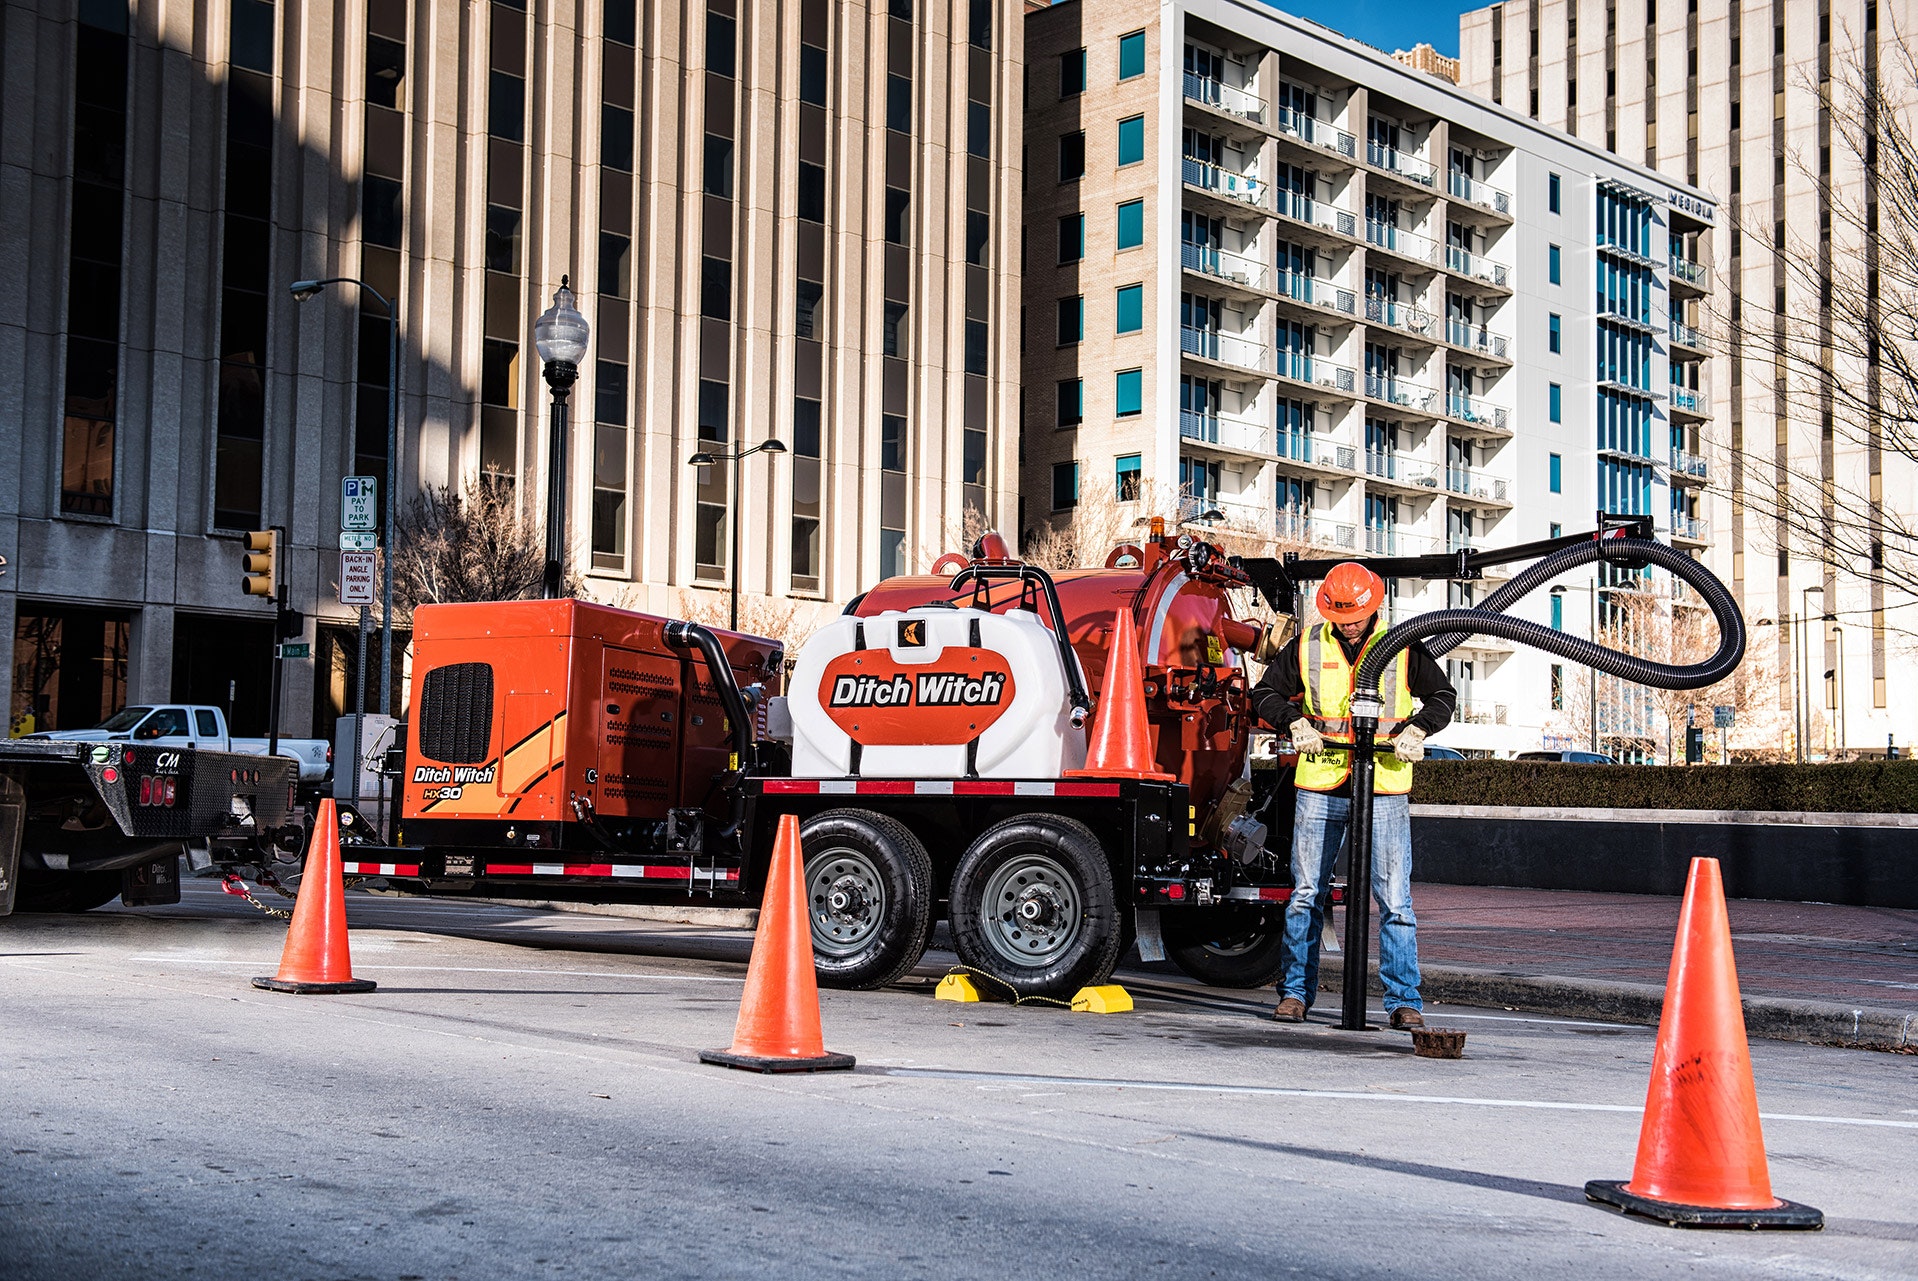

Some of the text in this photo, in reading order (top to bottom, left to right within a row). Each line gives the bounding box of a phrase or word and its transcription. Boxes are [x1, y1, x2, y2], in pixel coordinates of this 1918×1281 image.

[354, 505, 365, 513] TO
[348, 513, 370, 521] PARK
[345, 555, 372, 564] BACK-IN
[348, 565, 368, 573] ANGLE
[345, 575, 371, 583] PARKING
[349, 585, 366, 593] ONLY
[832, 675, 1000, 704] Ditch Witch
[156, 752, 180, 768] CM
[1321, 757, 1341, 765] Witch
[413, 767, 493, 783] Ditch Witch
[424, 787, 462, 799] HX30
